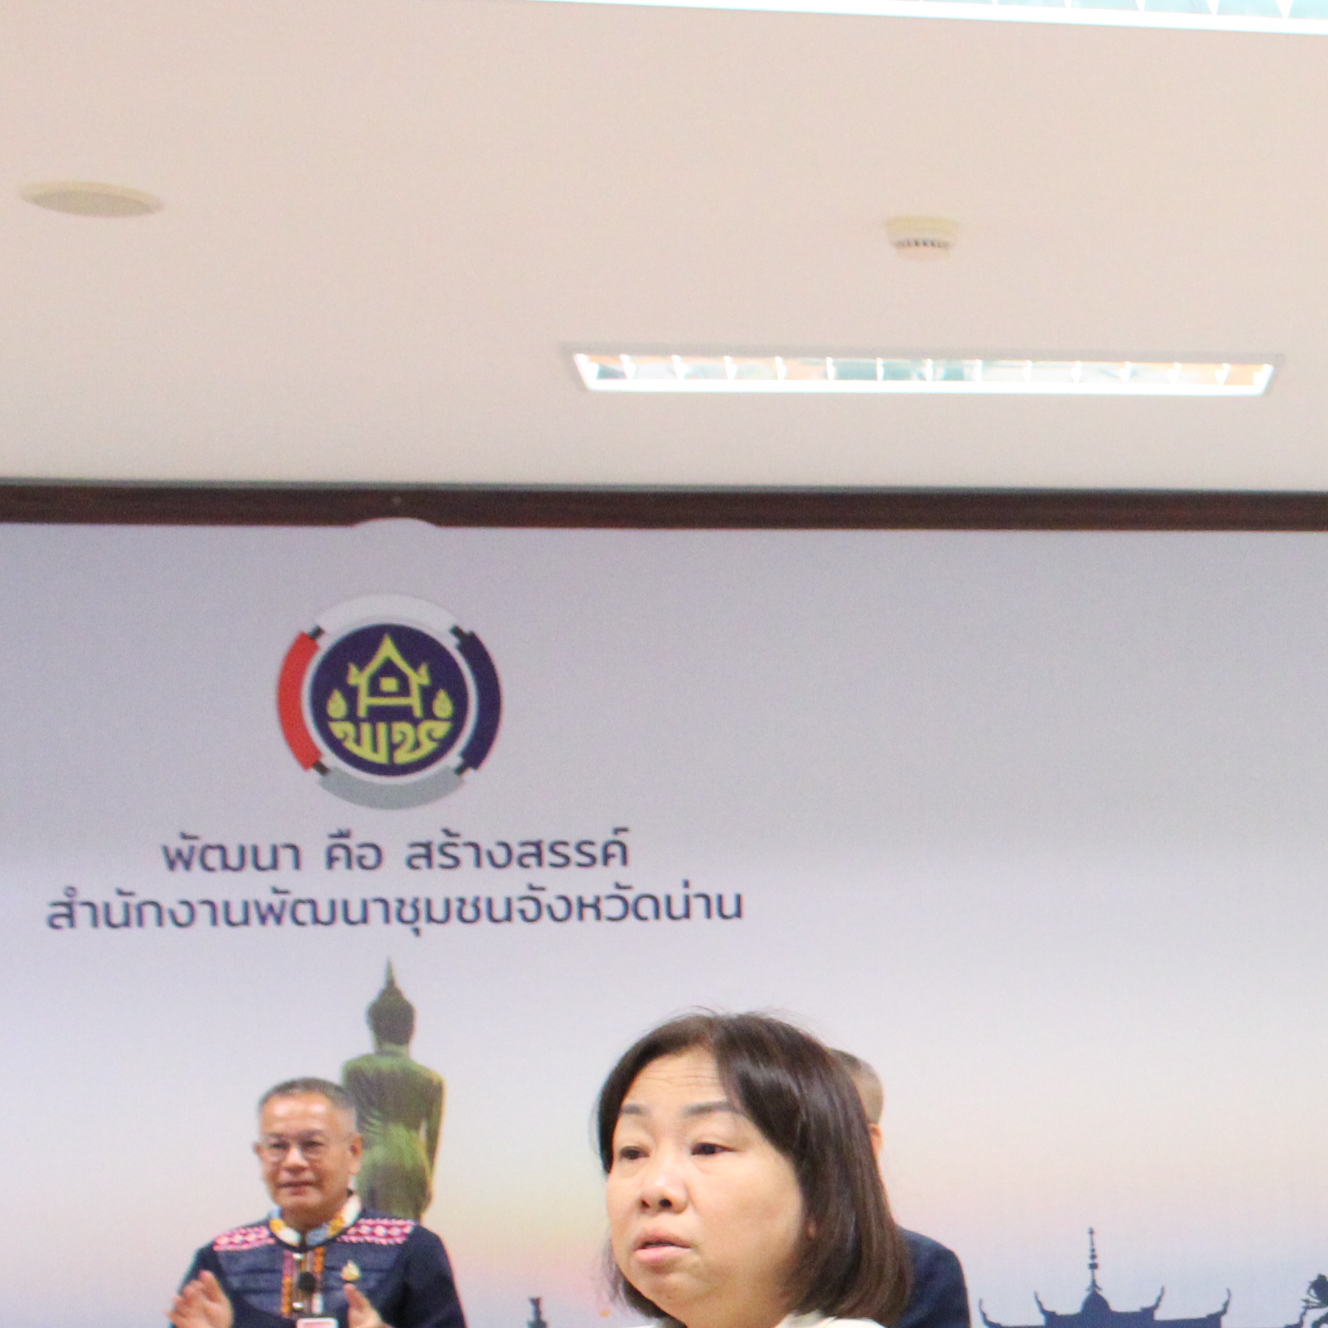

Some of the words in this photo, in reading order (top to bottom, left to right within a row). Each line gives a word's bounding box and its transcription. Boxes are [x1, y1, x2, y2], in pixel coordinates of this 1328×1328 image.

[161, 831, 301, 873] พัฒนา
[325, 828, 384, 871] คือ
[404, 826, 630, 871] สร้างสรรค์
[46, 879, 744, 938] สำนักงานพัฒนาชุมชนจังหวัดน่าน
